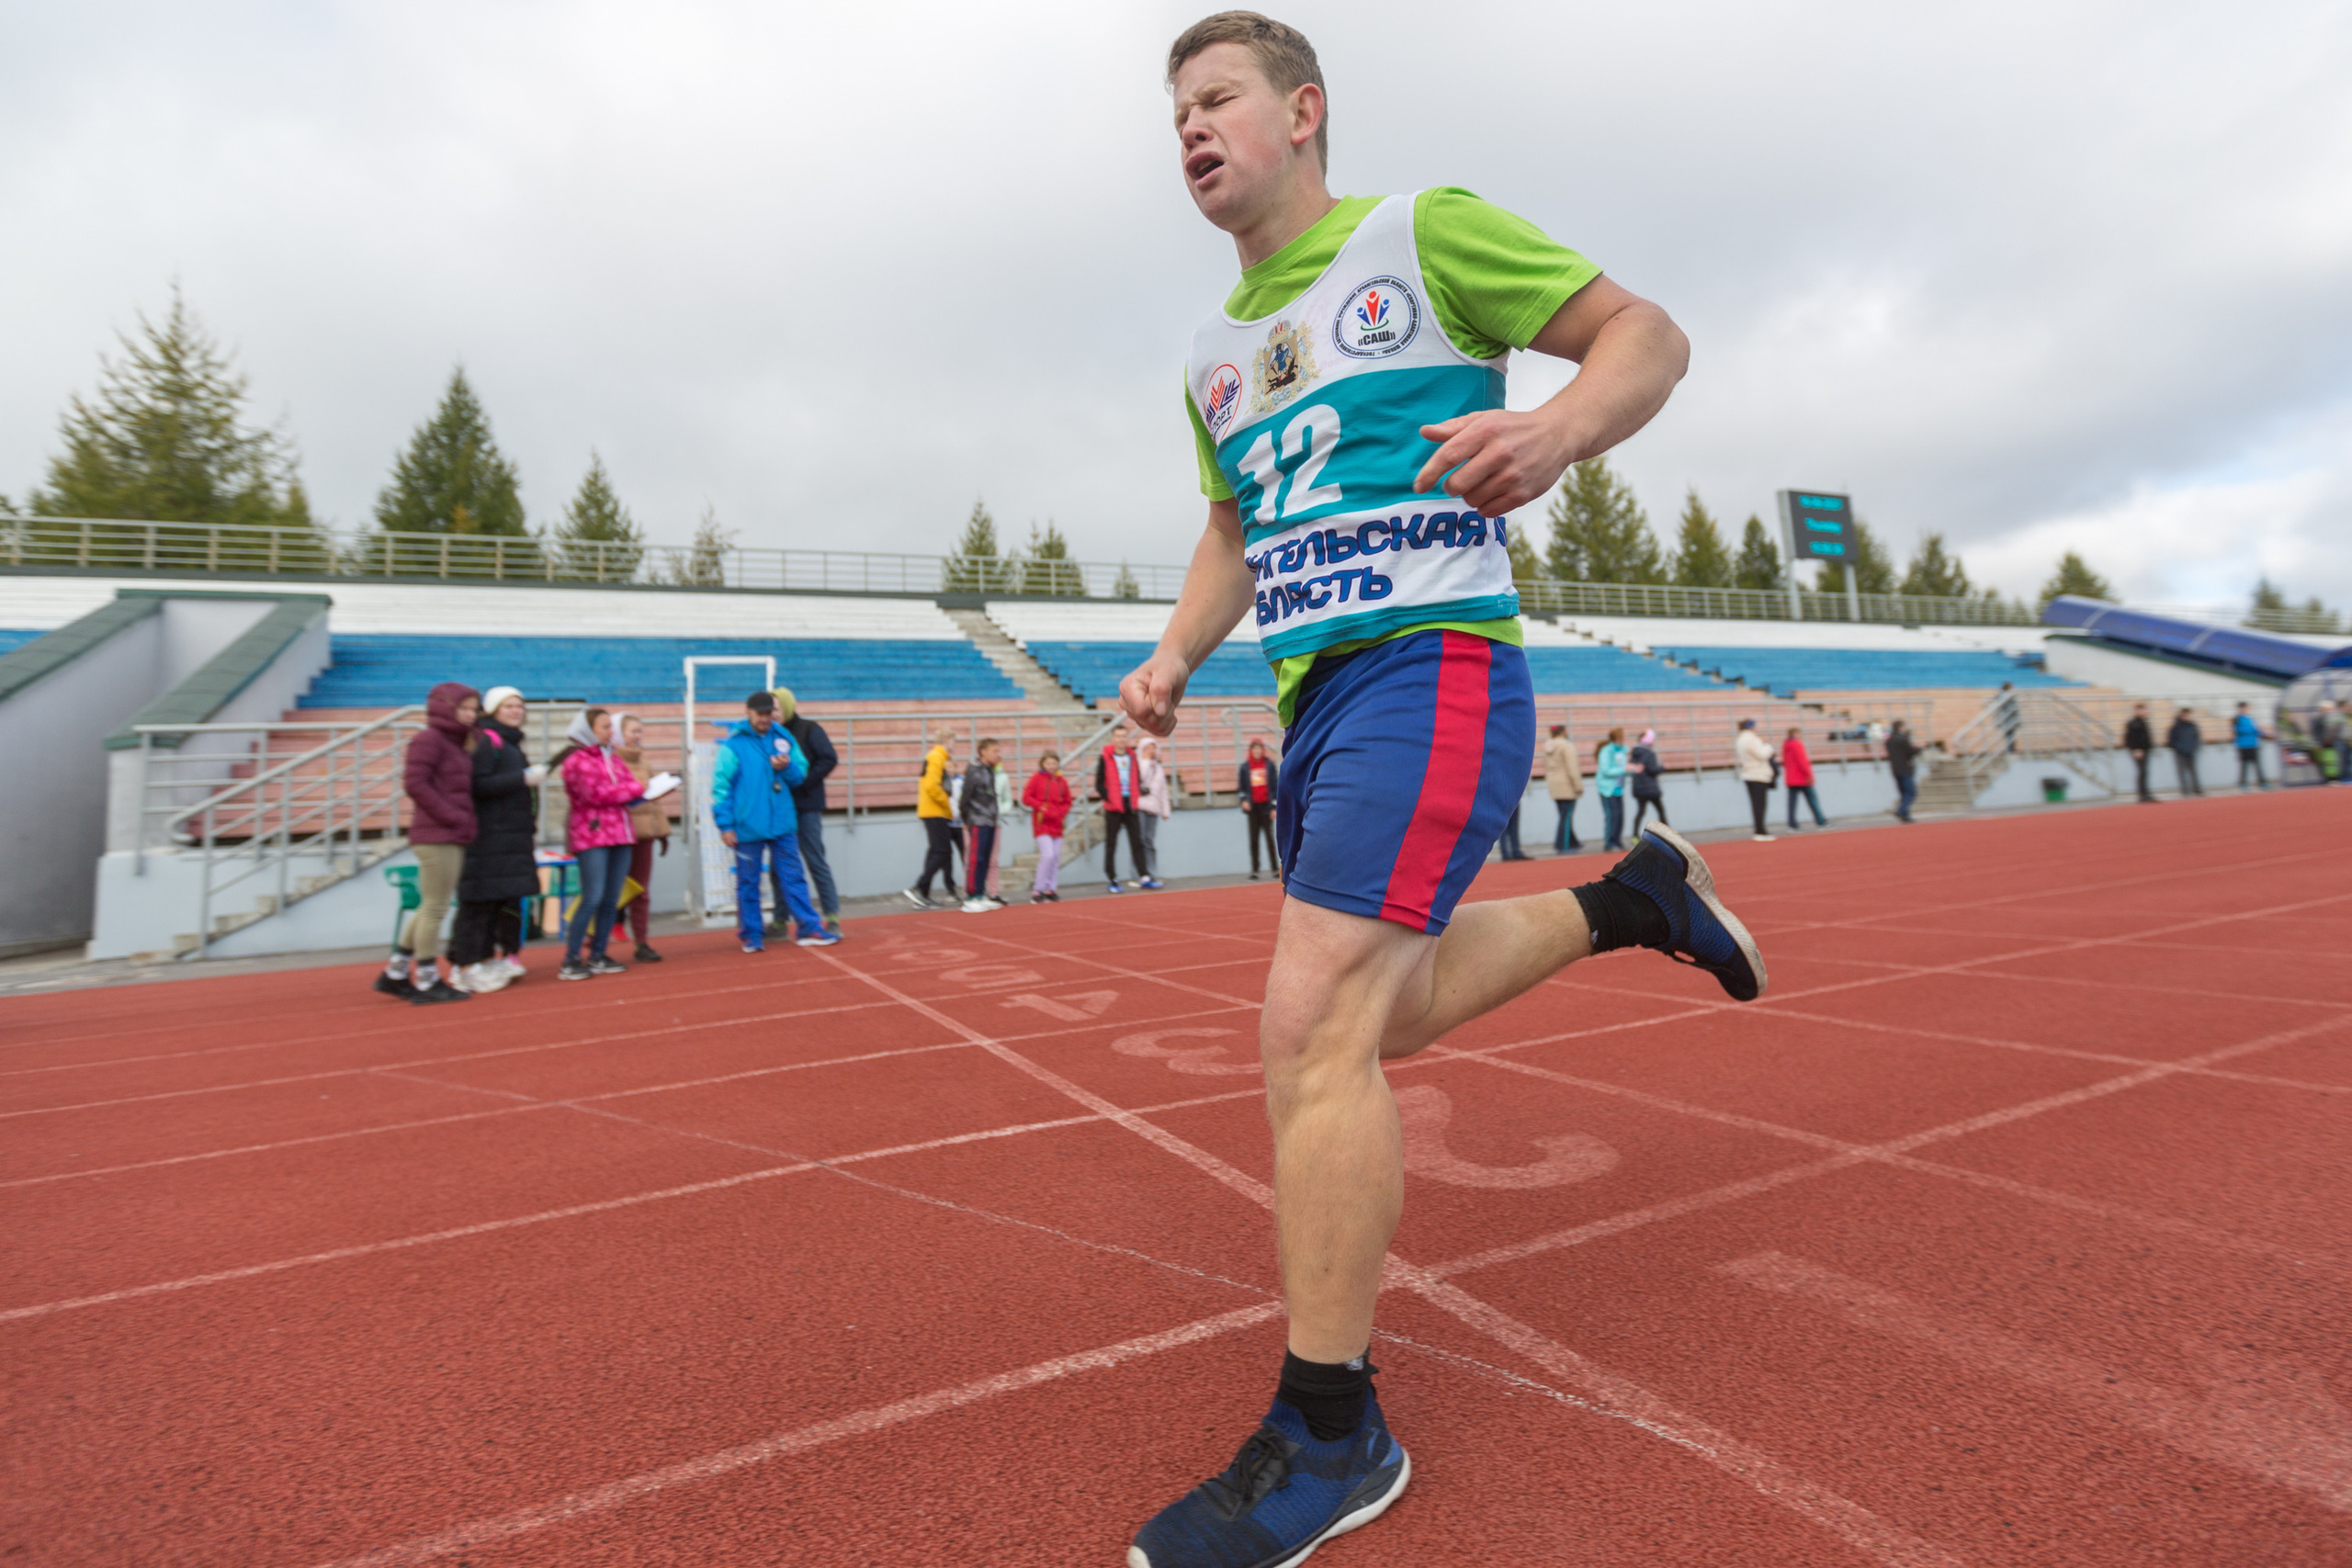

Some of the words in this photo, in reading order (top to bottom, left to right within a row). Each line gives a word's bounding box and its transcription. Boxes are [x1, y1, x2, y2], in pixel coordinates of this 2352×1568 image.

[1357, 278, 1390, 293] АРХАНГЕЛЬСКОЙ
[1211, 404, 1232, 437] ПОРТ
[1237, 403, 1342, 525] 12
[1245, 511, 1487, 581] НГЕЛЬСКАЯ
[1256, 566, 1393, 626] БЛАСТЬ
[938, 964, 1045, 989] 5
[998, 990, 1120, 1022] 4
[1111, 1027, 1263, 1076] 3
